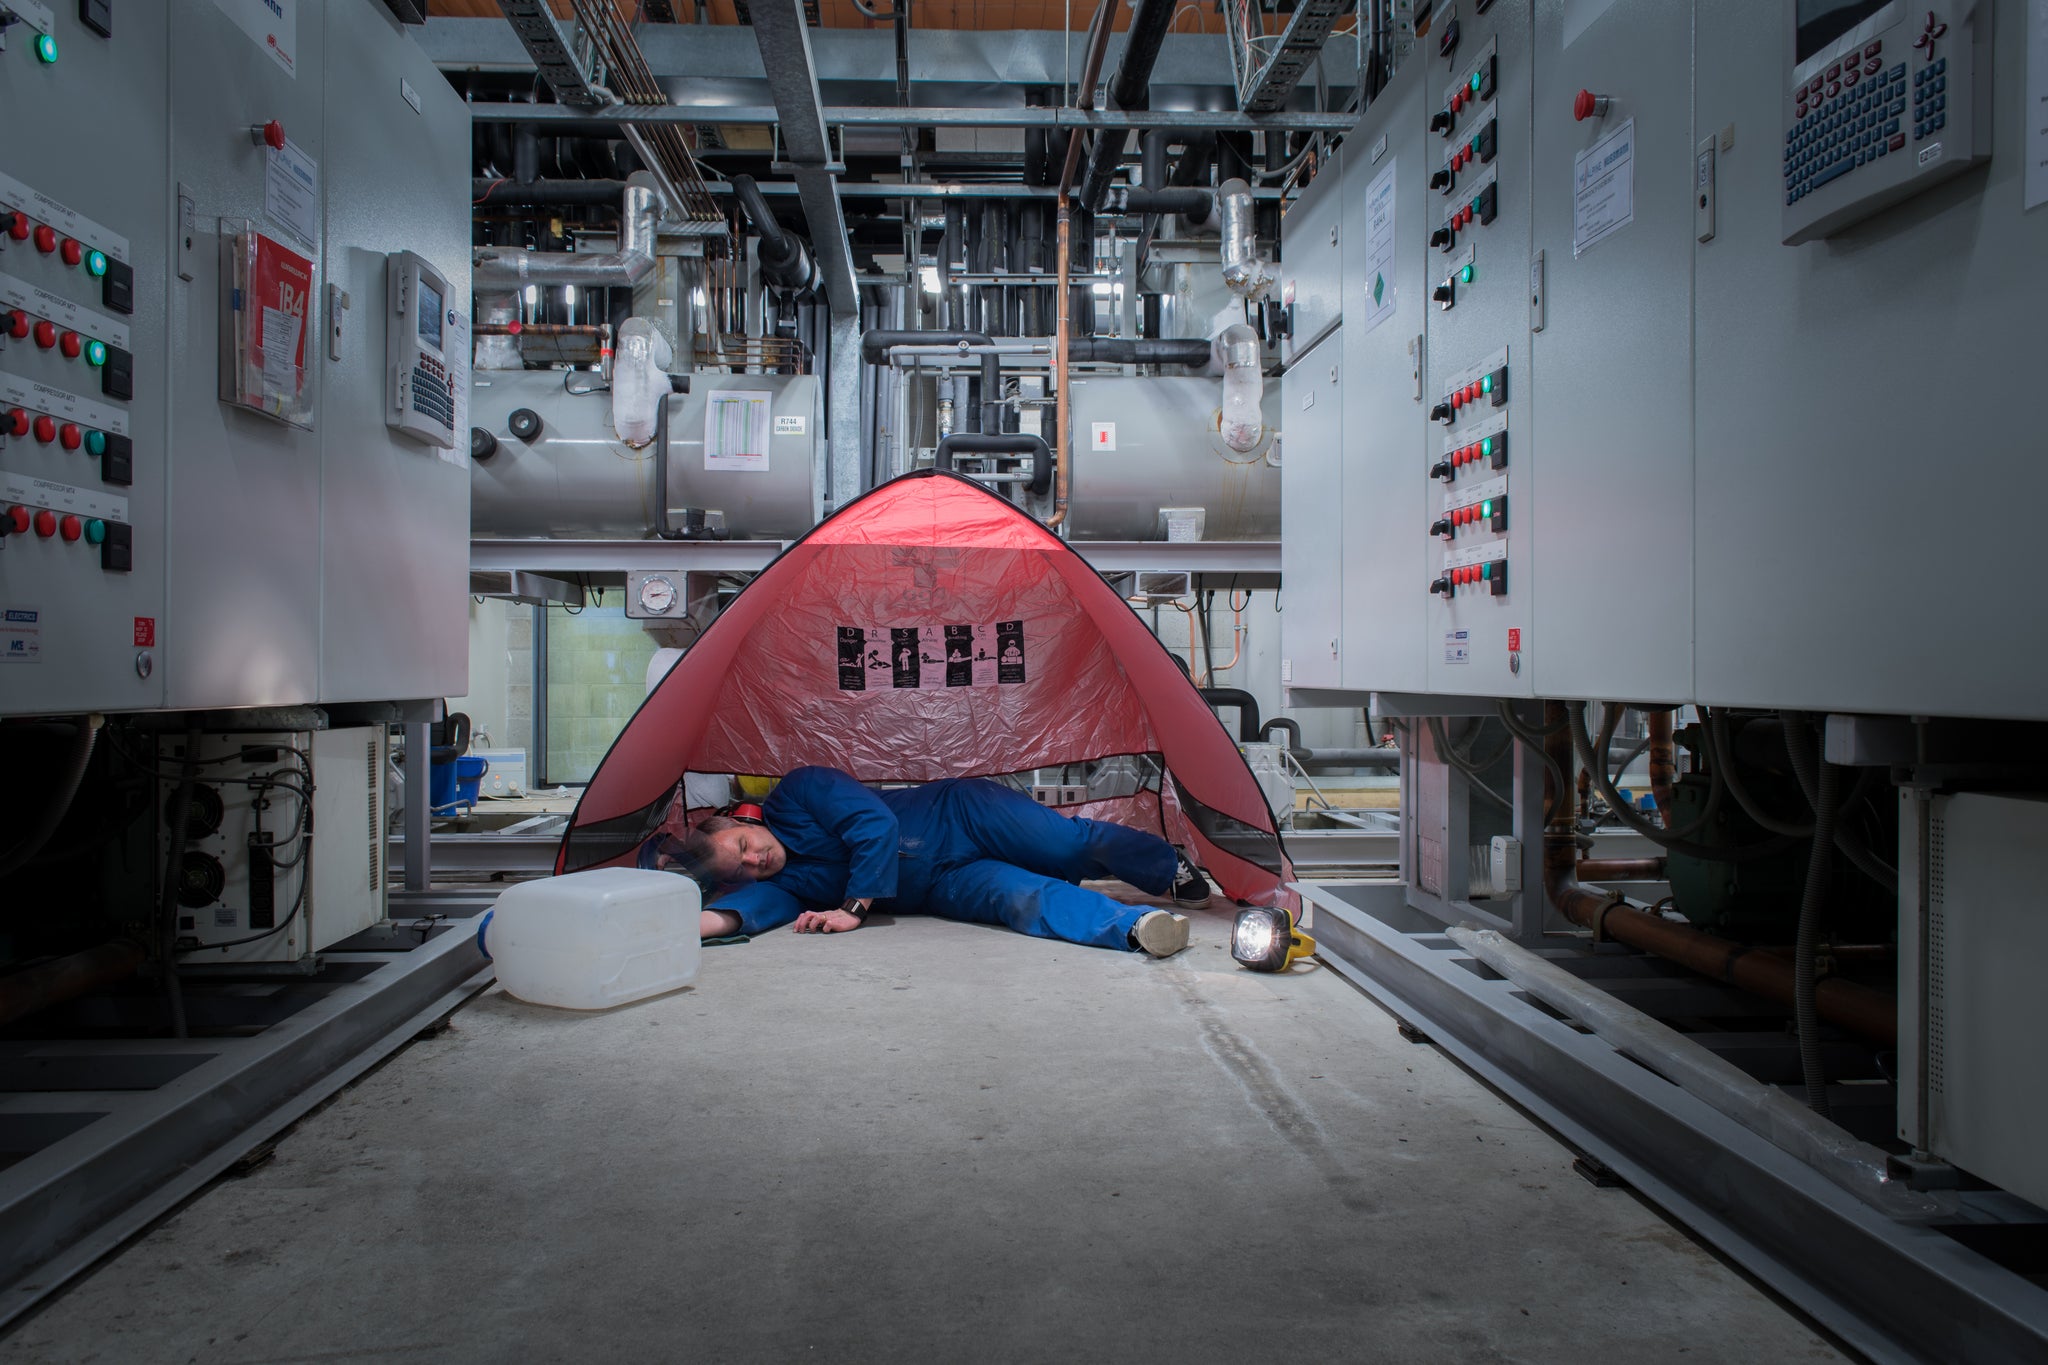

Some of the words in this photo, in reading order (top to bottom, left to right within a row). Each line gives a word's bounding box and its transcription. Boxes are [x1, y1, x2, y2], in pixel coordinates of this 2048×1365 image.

[279, 281, 305, 320] 1B4
[8, 612, 35, 620] ELECTRICS
[951, 626, 958, 634] B
[1006, 623, 1014, 631] D
[846, 629, 854, 637] D
[872, 630, 878, 638] R
[902, 629, 908, 638] S
